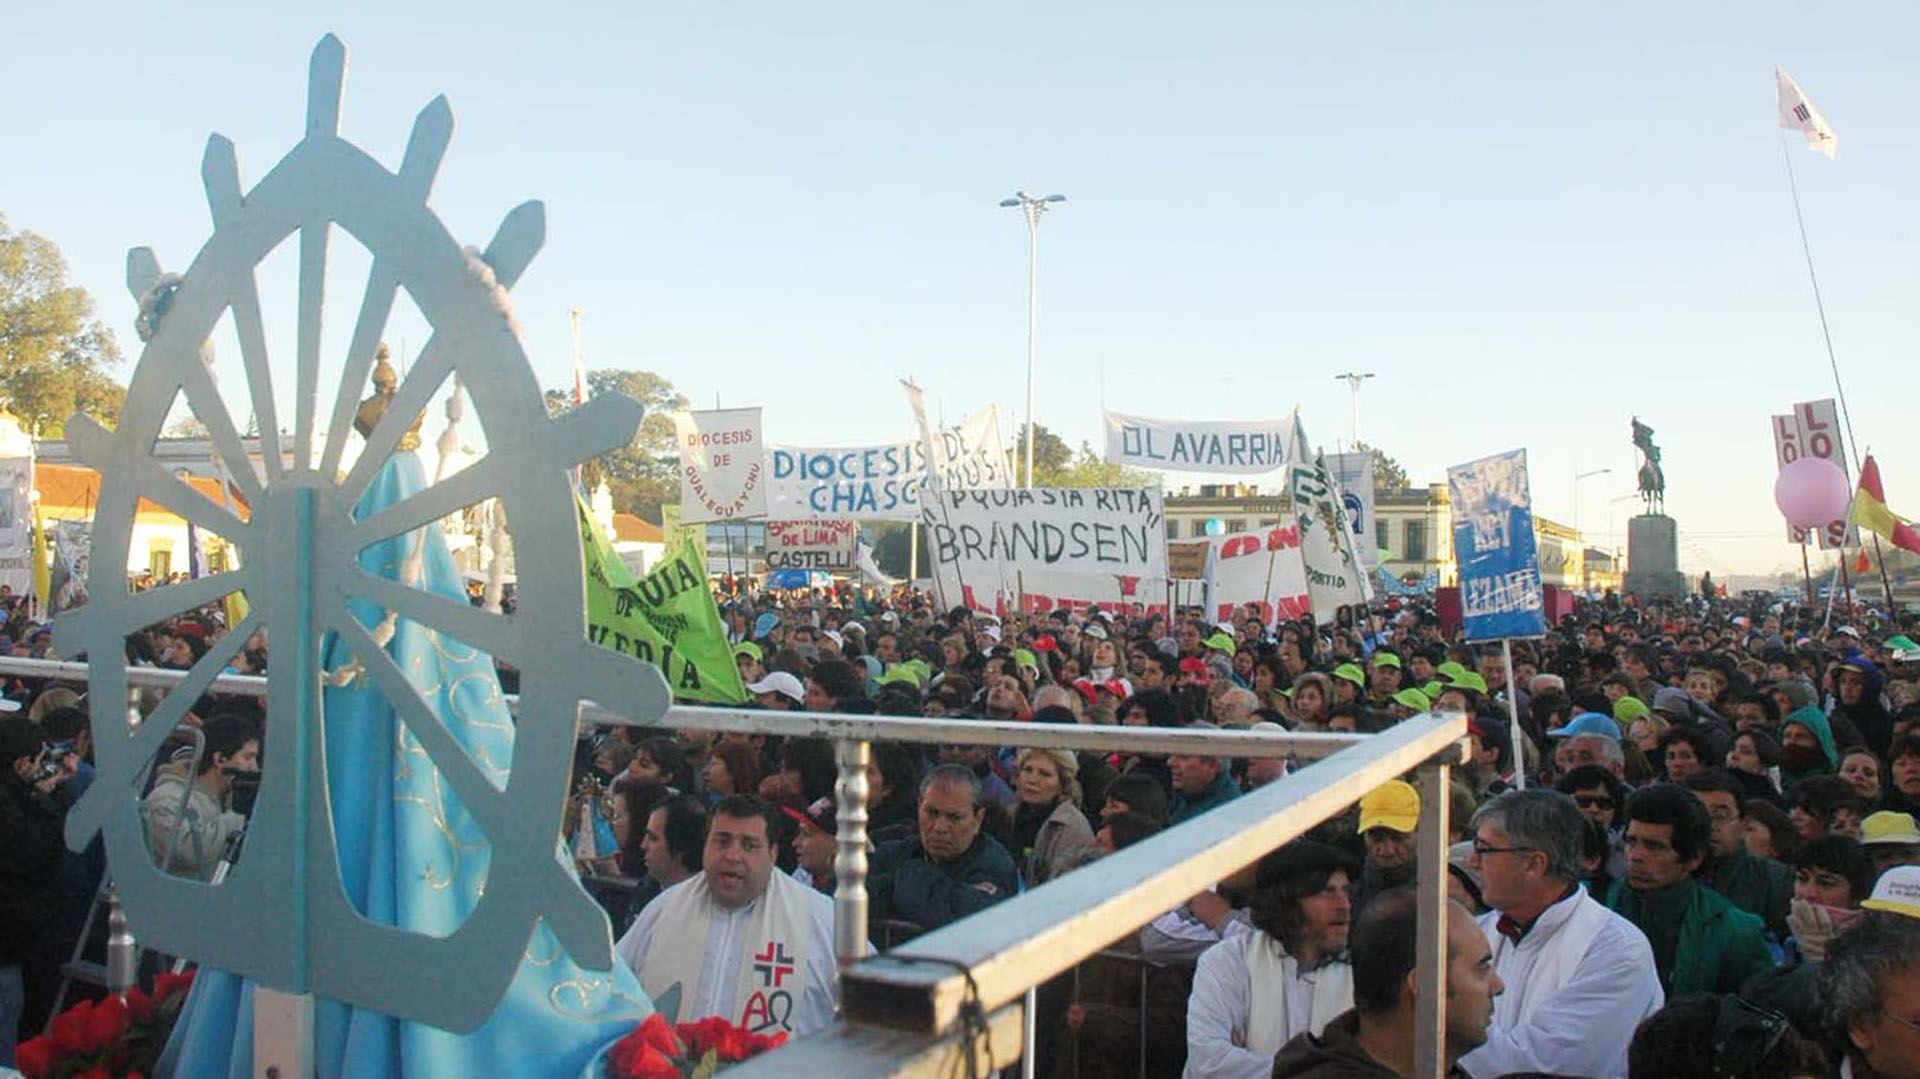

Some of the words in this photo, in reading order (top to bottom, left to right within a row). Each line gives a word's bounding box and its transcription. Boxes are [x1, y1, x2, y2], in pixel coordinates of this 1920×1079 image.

[687, 429, 752, 446] DIOCESIS
[1122, 424, 1284, 465] OLAVARRIA
[713, 454, 732, 467] DE
[773, 441, 927, 480] DIOCESIS
[782, 534, 799, 547] DE
[803, 528, 838, 547] LIMA
[767, 550, 851, 568] CASTELLI
